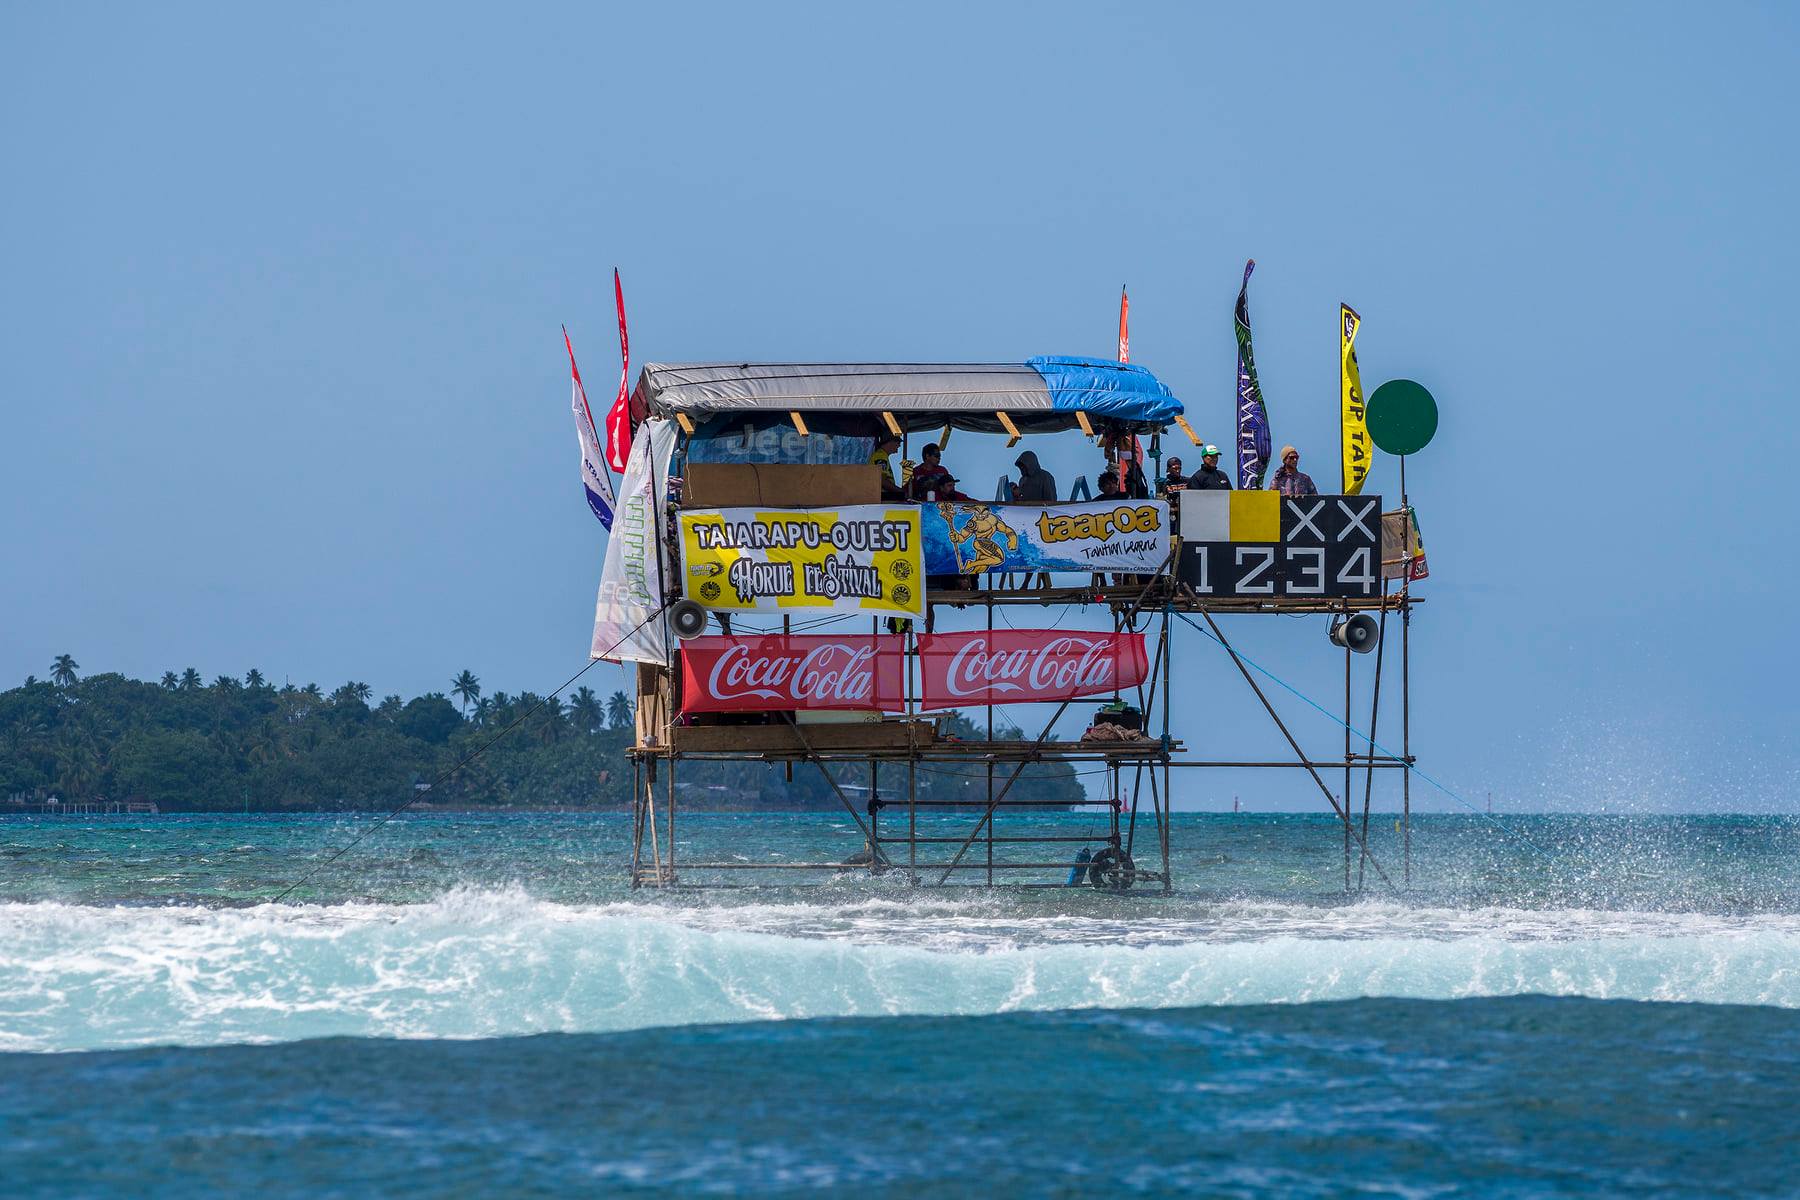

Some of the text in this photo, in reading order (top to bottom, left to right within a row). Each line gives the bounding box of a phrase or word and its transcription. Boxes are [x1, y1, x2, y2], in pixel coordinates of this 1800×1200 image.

[726, 423, 834, 464] Jeep
[692, 520, 910, 552] TAIARAPU-OUEST
[1036, 505, 1161, 543] taaroa
[1123, 537, 1157, 560] Legend
[708, 643, 881, 701] Coca-Cola
[946, 637, 1114, 697] Coca-Cola
